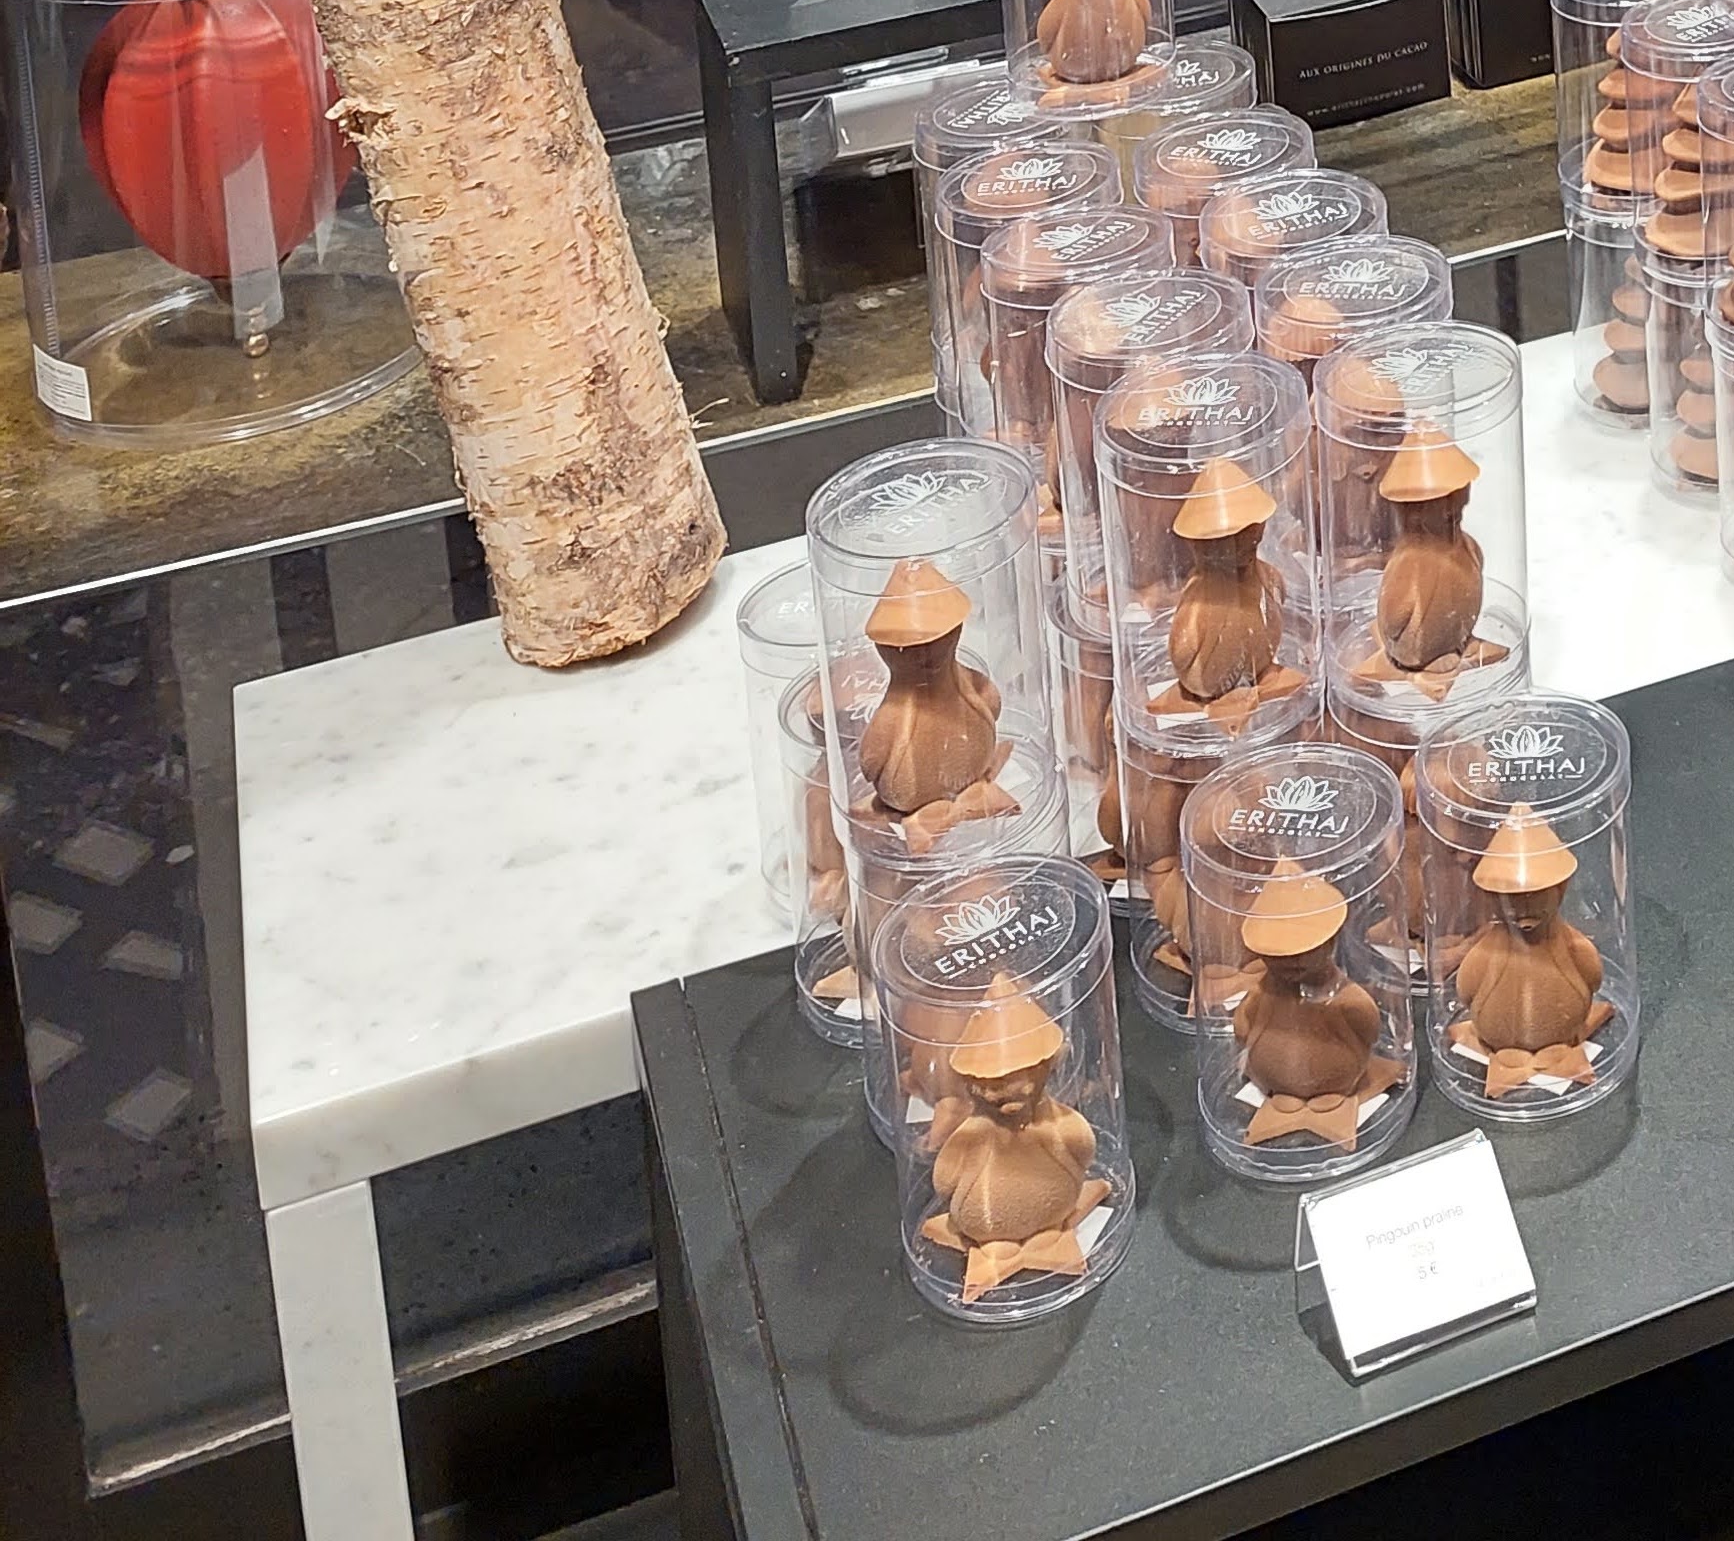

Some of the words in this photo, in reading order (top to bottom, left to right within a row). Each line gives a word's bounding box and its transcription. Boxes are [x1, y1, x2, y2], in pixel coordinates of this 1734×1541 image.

[1299, 68, 1321, 79] AUX
[1323, 57, 1373, 75] ORIGINES
[1377, 51, 1392, 63] DU
[1394, 41, 1428, 57] CACAO
[1170, 145, 1263, 166] ERITHAJ
[977, 174, 1077, 194] ERITHAJ
[1248, 201, 1349, 238] ERITHAJ
[1298, 281, 1407, 297] ERITHAJ
[1136, 404, 1255, 422] ERITHAJ
[1468, 756, 1586, 778] ERITHAJ
[1230, 808, 1350, 834] ERITHAJ
[934, 905, 1061, 974] ERITHAJ
[1366, 1221, 1421, 1252] Pingouin
[1418, 1265, 1428, 1280] 5
